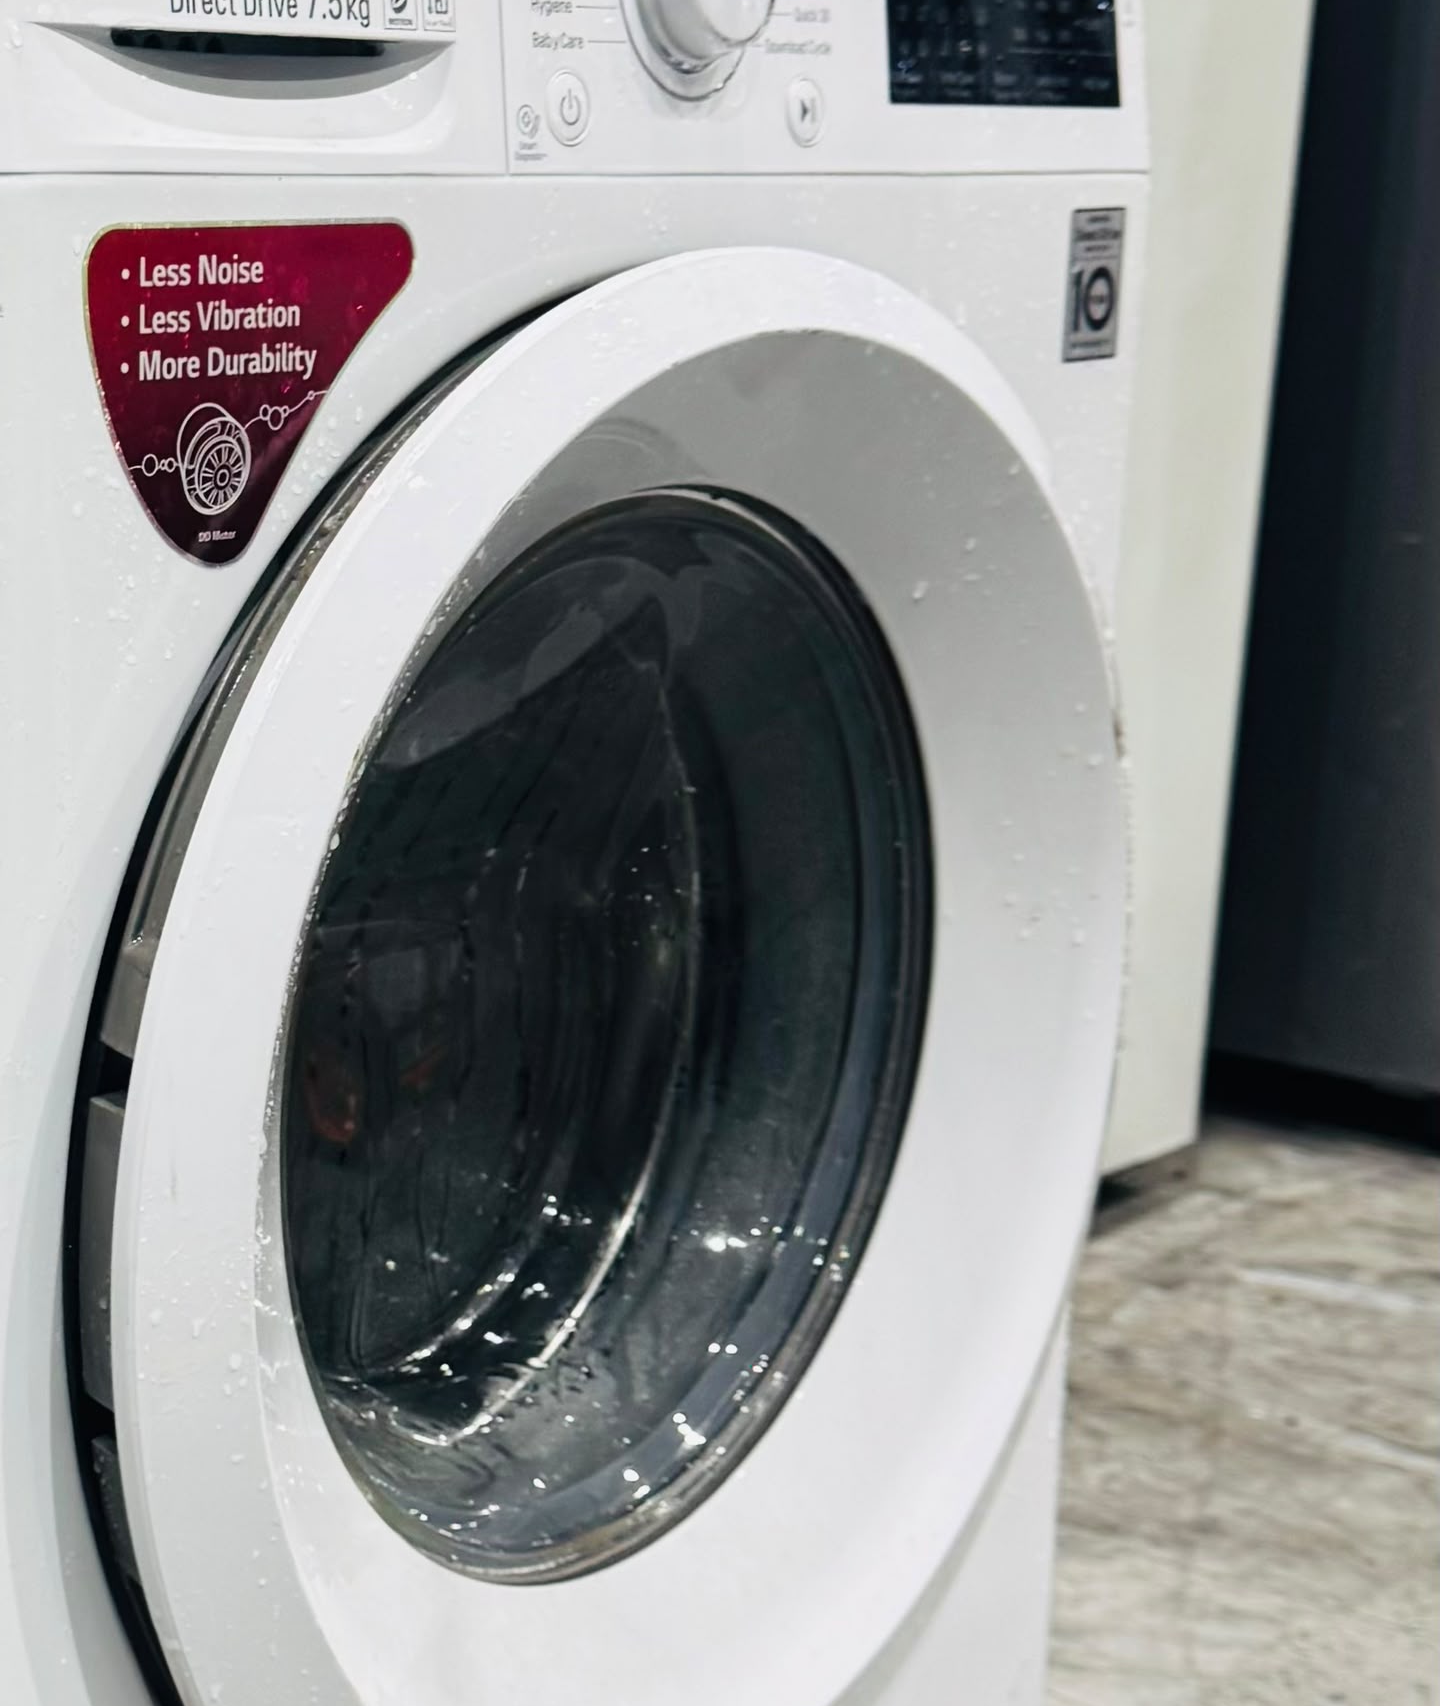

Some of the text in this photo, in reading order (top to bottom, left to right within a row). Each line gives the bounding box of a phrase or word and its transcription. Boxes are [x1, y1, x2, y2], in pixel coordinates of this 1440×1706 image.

[139, 254, 264, 287] Less Noise
[139, 298, 301, 335] Less Vibration
[1072, 266, 1114, 331] 10
[139, 341, 317, 381] More Durability
